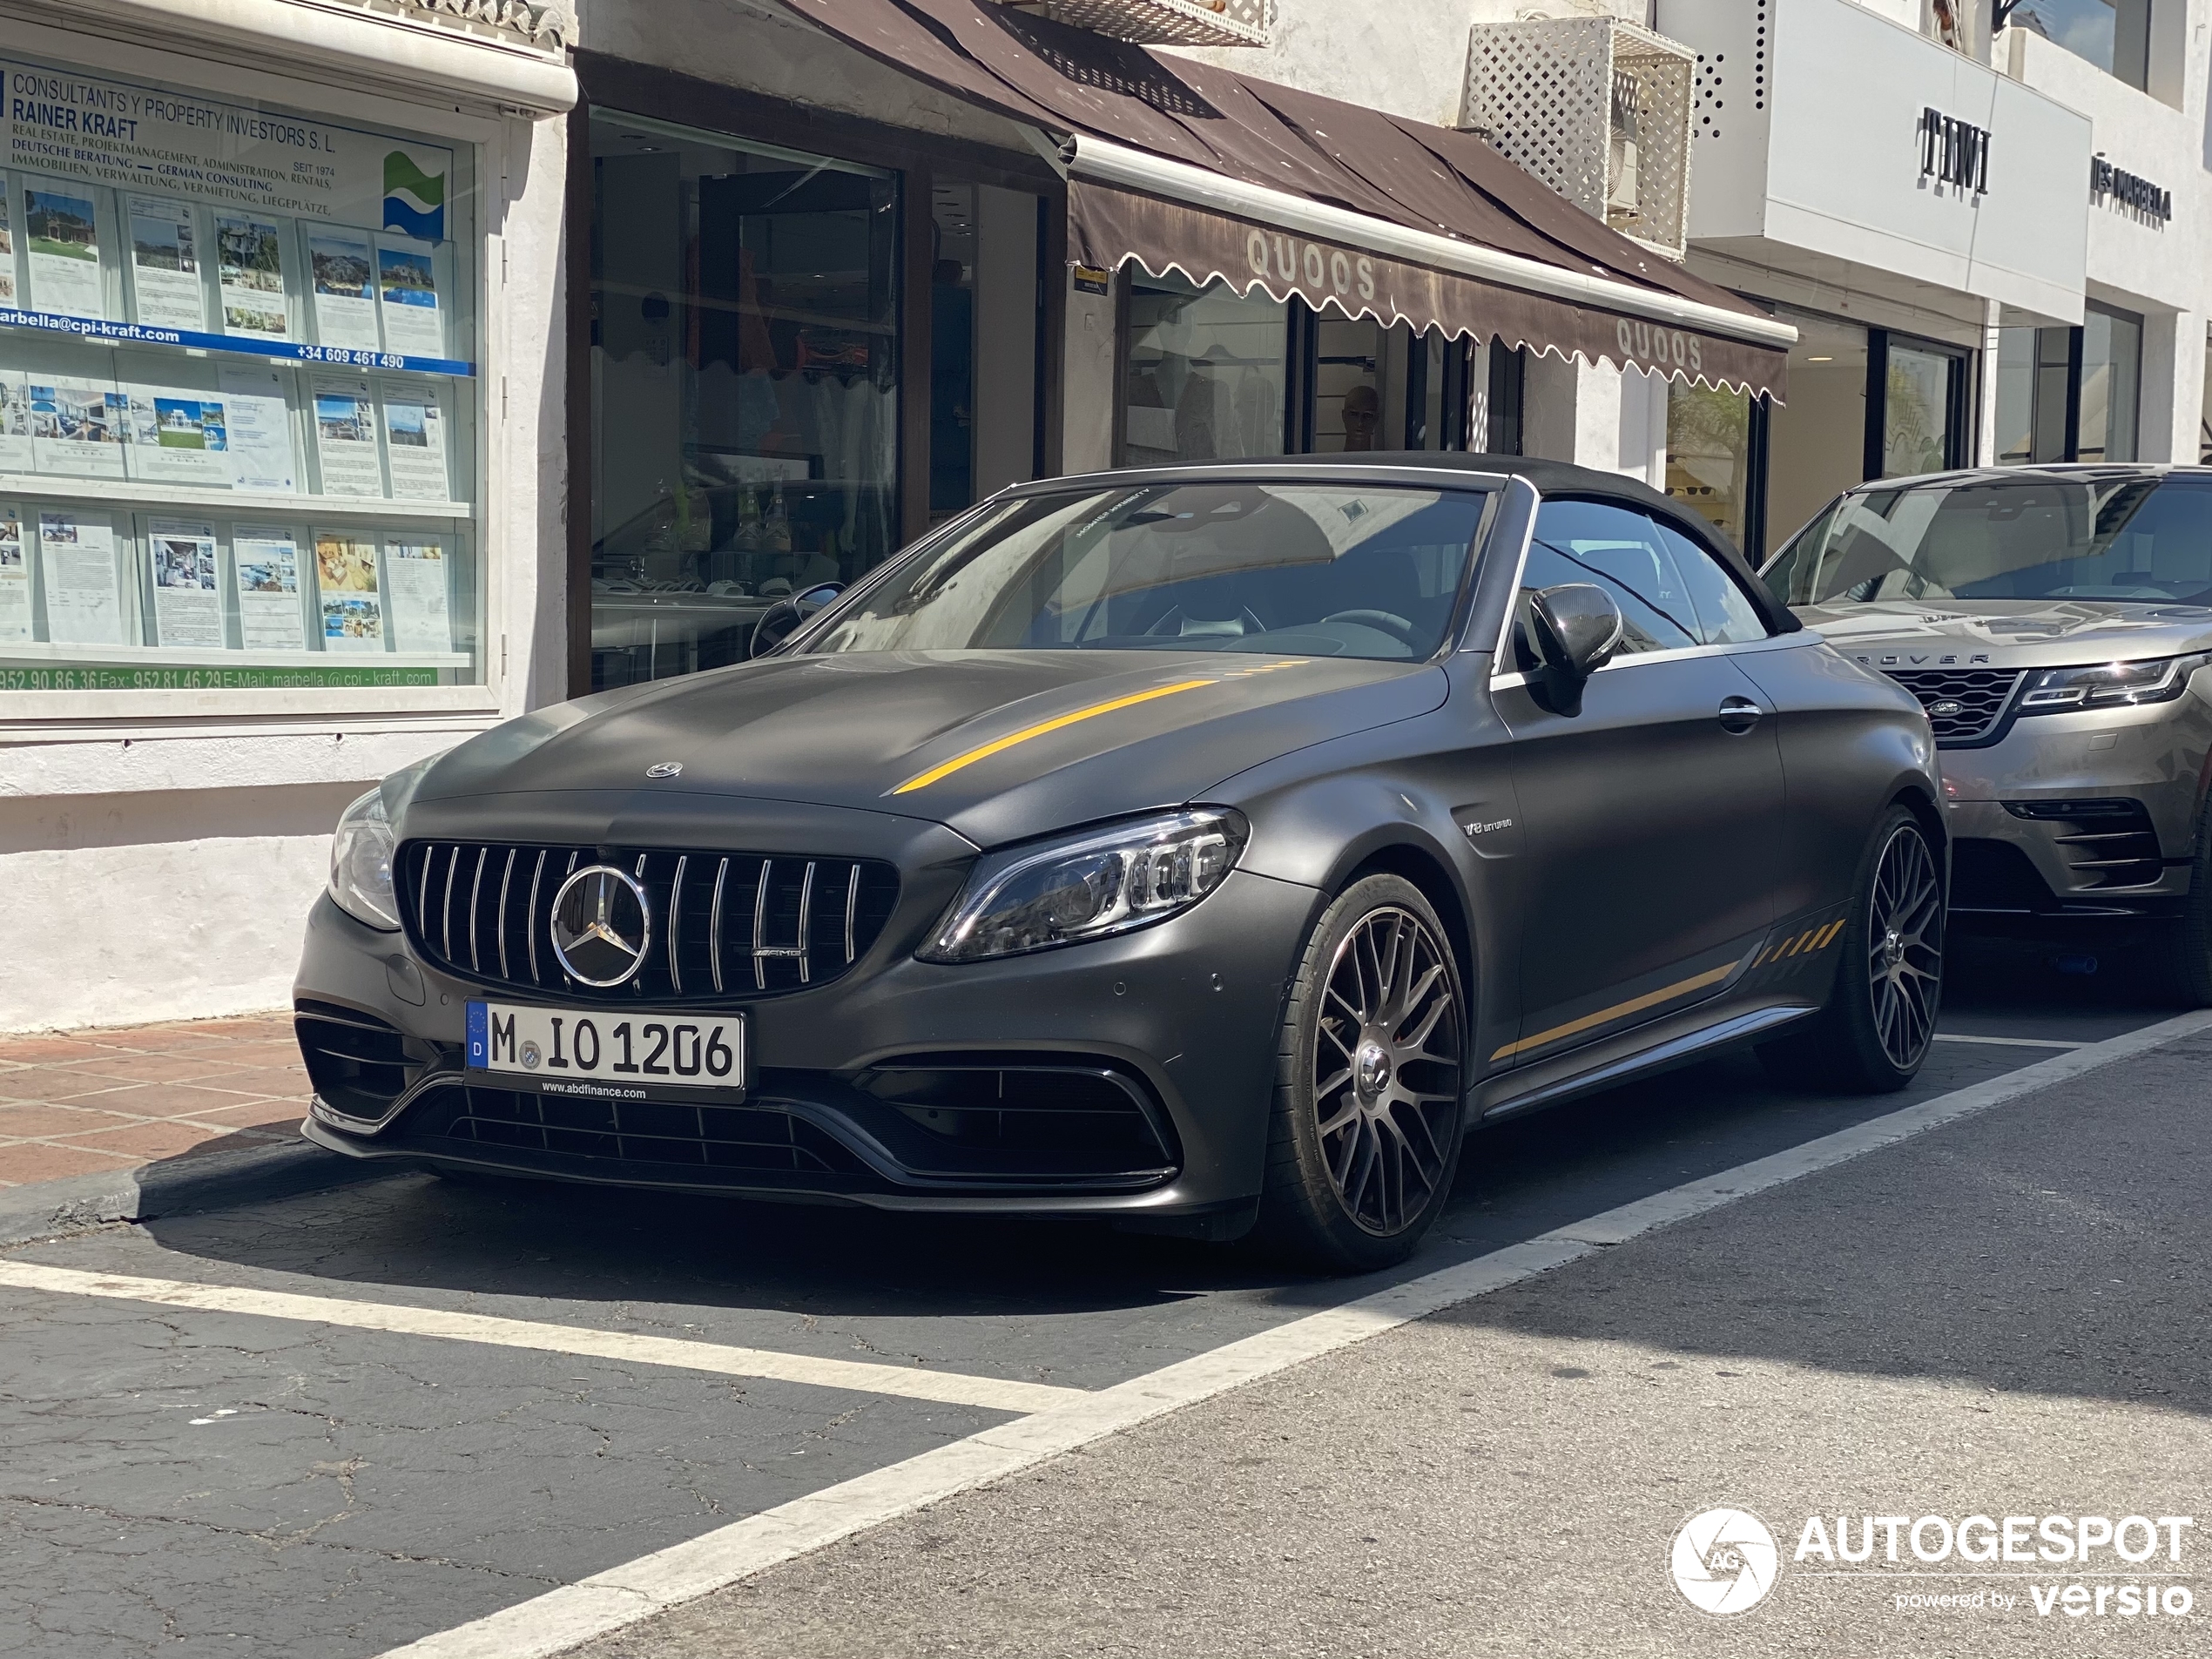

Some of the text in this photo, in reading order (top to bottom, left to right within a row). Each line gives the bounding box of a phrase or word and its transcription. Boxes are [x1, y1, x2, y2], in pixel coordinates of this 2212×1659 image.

[12, 98, 138, 141] RAINER KRAFT
[13, 74, 335, 153] CONSULTANTS Y PROPERTY INVESTORS S. L.
[12, 124, 332, 191] REAL ESTATE, PROJEKTMANAGEMENT, ADMINISTRATION, RENTALS,
[12, 138, 71, 158] DEUTSCHE
[74, 150, 133, 169] BERATUNG
[158, 164, 203, 180] GERMAN
[206, 172, 273, 192] CONSULTING
[293, 161, 334, 177] SEIT 1974
[1923, 106, 1992, 195] TIWI
[12, 153, 332, 216] IMMOBILIEN, VERWALTUNG, VERMIETUNG, LIEGEPLÄTZE,
[2113, 167, 2171, 221] MARBELLA
[1246, 229, 1374, 300] QUOOS
[297, 345, 404, 368] +34 609 461 490
[1616, 319, 1702, 371] QUOOS
[0, 671, 25, 689] 952
[30, 671, 50, 689] 90
[55, 671, 74, 689] 86
[80, 671, 96, 689] 36
[134, 671, 159, 689] 952
[164, 671, 178, 689] 81
[183, 671, 200, 689] 46
[206, 671, 221, 689] 29
[273, 671, 324, 687] marbella
[1857, 654, 1989, 665] ROVER
[1464, 819, 1513, 836] V8 BITURBO
[473, 1042, 482, 1056] D
[492, 1012, 732, 1077] M IO 1206
[542, 1081, 646, 1099] www.abdfinance.com
